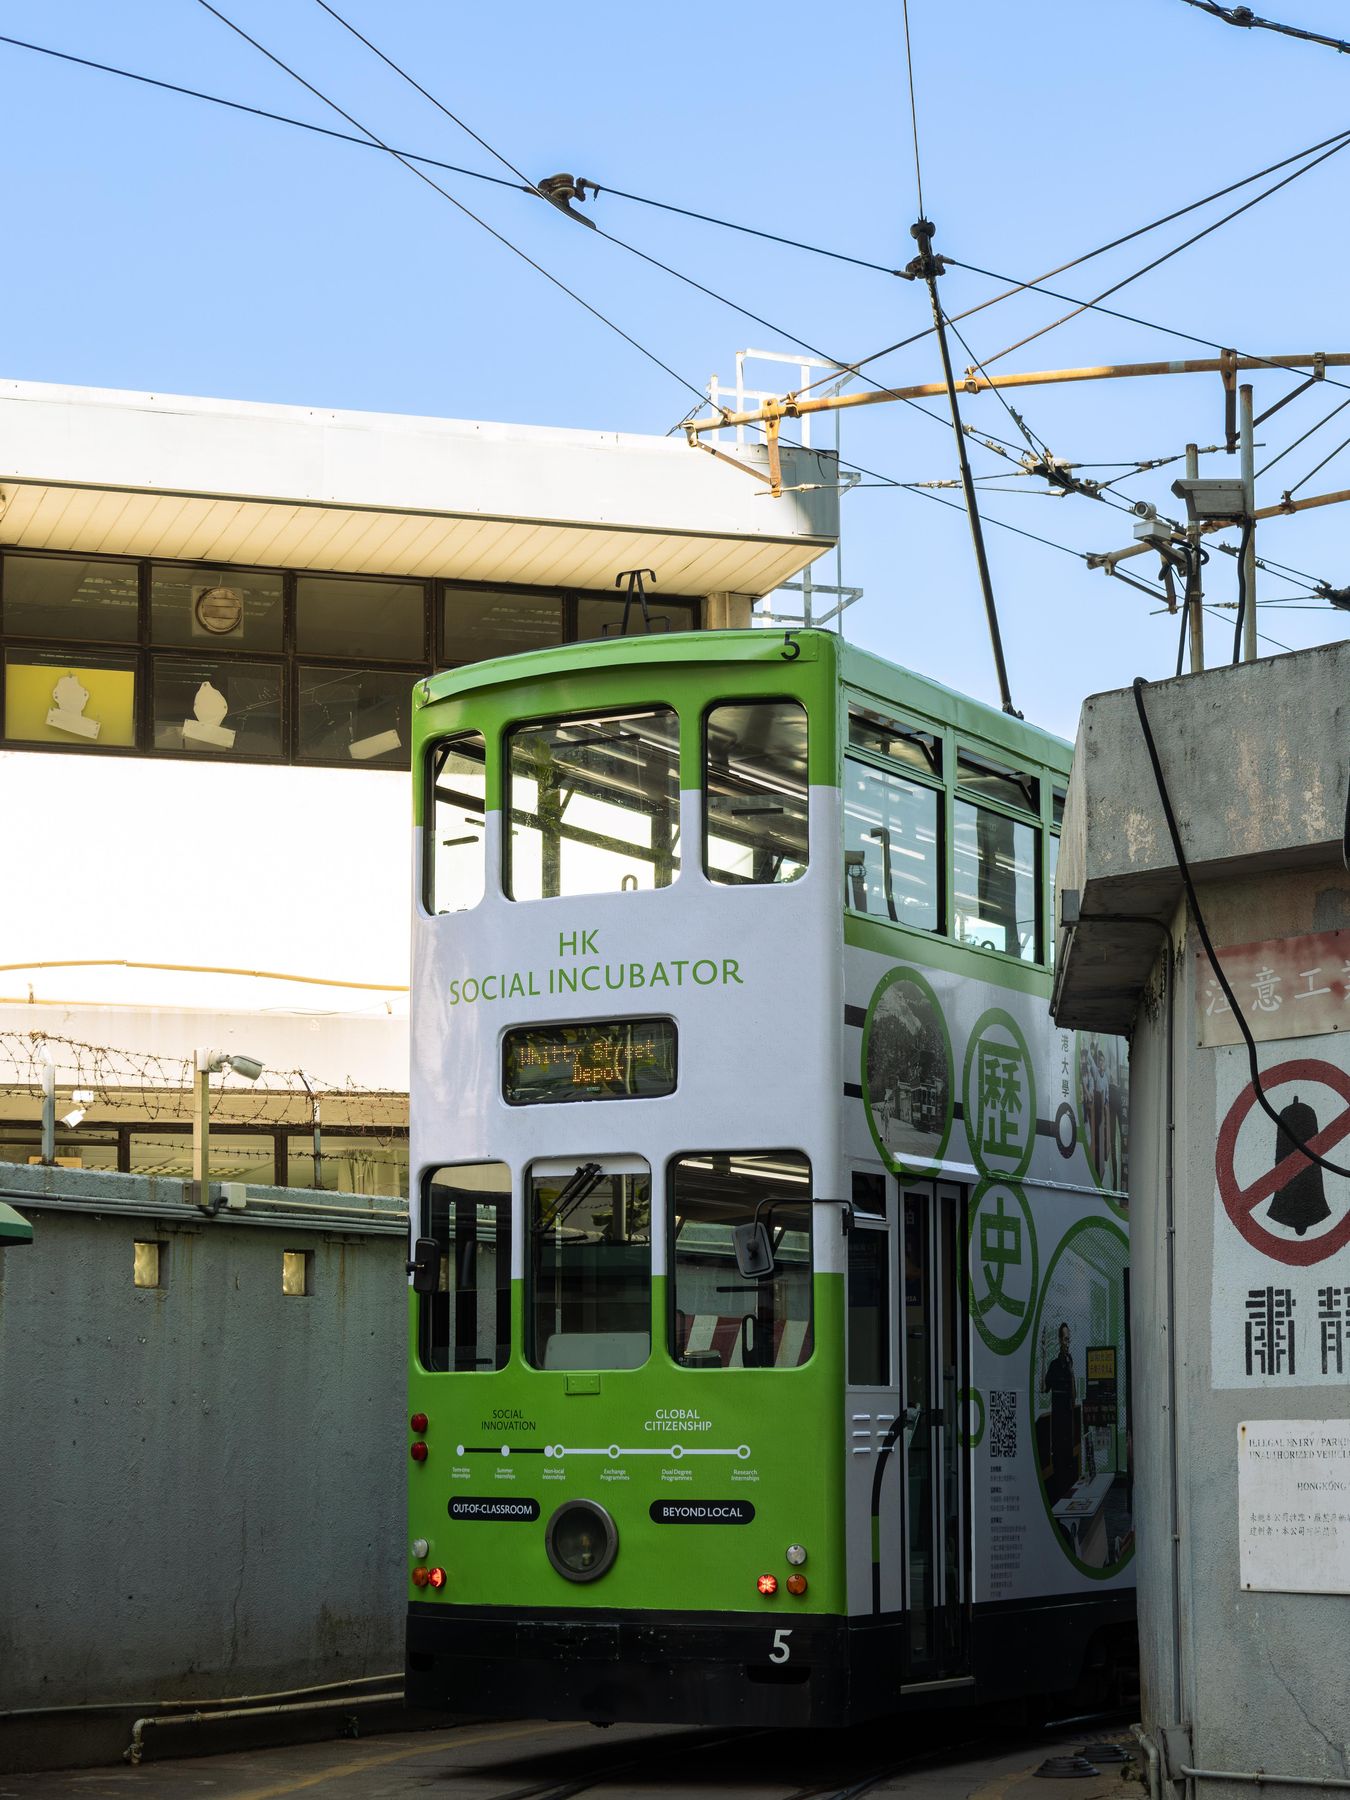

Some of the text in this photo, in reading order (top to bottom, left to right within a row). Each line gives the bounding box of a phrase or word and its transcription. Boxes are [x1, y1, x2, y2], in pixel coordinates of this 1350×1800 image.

[781, 630, 800, 660] 5
[559, 929, 599, 956] HK
[450, 959, 744, 1005] SOCIAL INCUBATOR
[1205, 959, 1350, 1017] 注意工
[519, 1039, 655, 1066] Whitty Street
[573, 1064, 623, 1083] Depot
[492, 1410, 524, 1419] SOCIAL
[655, 1409, 700, 1419] GLOBAL
[481, 1421, 536, 1431] INNOVATION
[644, 1421, 712, 1431] CITIZENSHIP
[603, 1468, 626, 1476] Exchange
[674, 1468, 692, 1476] Degree
[600, 1474, 630, 1482] Programmes
[453, 1503, 533, 1515] OUT-OF-CLASSROOM
[662, 1507, 743, 1517] BEYOND LOCAL
[769, 1629, 793, 1664] 5
